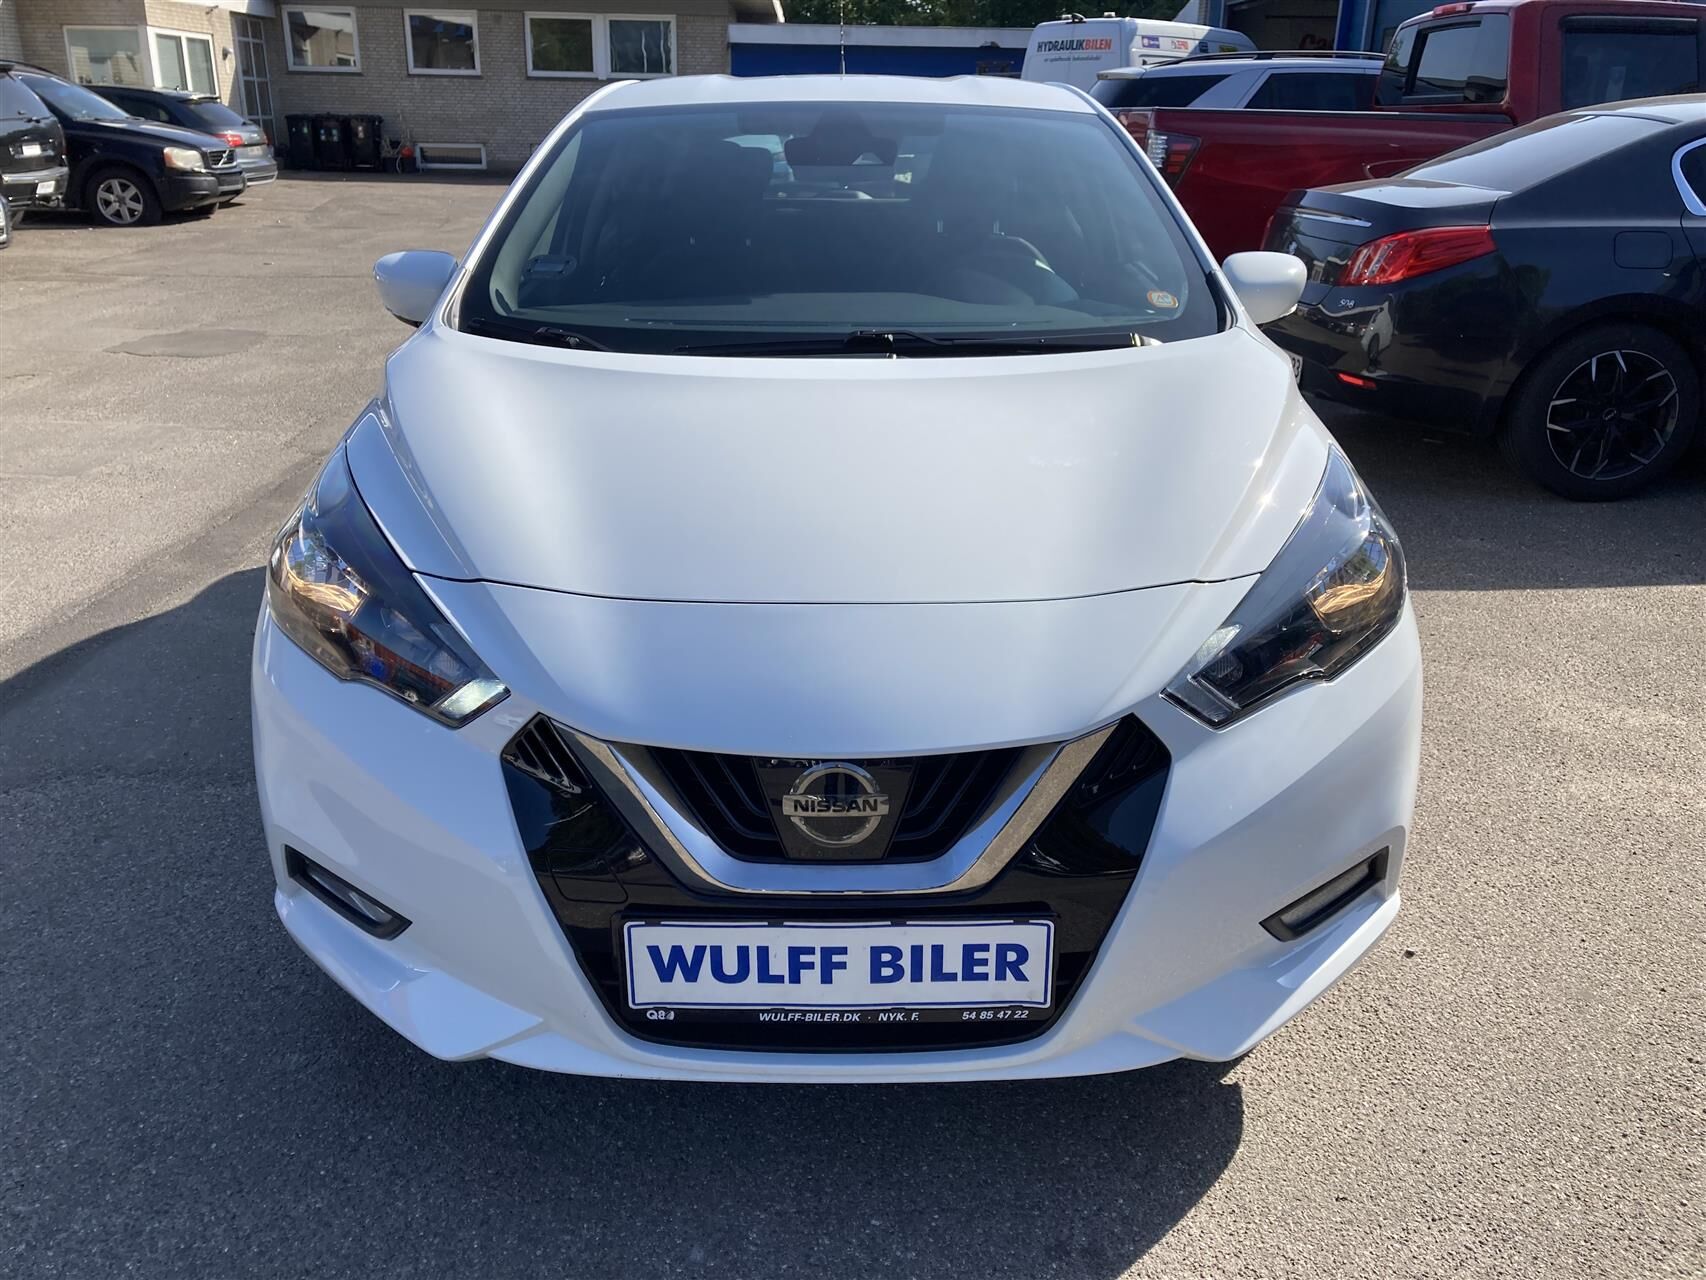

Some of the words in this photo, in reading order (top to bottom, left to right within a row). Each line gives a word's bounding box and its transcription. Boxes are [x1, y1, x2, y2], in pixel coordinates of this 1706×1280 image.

[1037, 38, 1112, 52] HYDRAULIKBILEN
[1299, 34, 1334, 49] Ca
[793, 799, 878, 812] NISSAN
[646, 944, 848, 985] WULFF
[870, 943, 1029, 984] BILER
[758, 1012, 860, 1022] WULFF-BILER.DK
[878, 1012, 907, 1021] NYK.
[961, 1011, 976, 1020] 54
[979, 1011, 995, 1020] 85
[996, 1010, 1012, 1020] 47
[1013, 1010, 1028, 1019] 22
